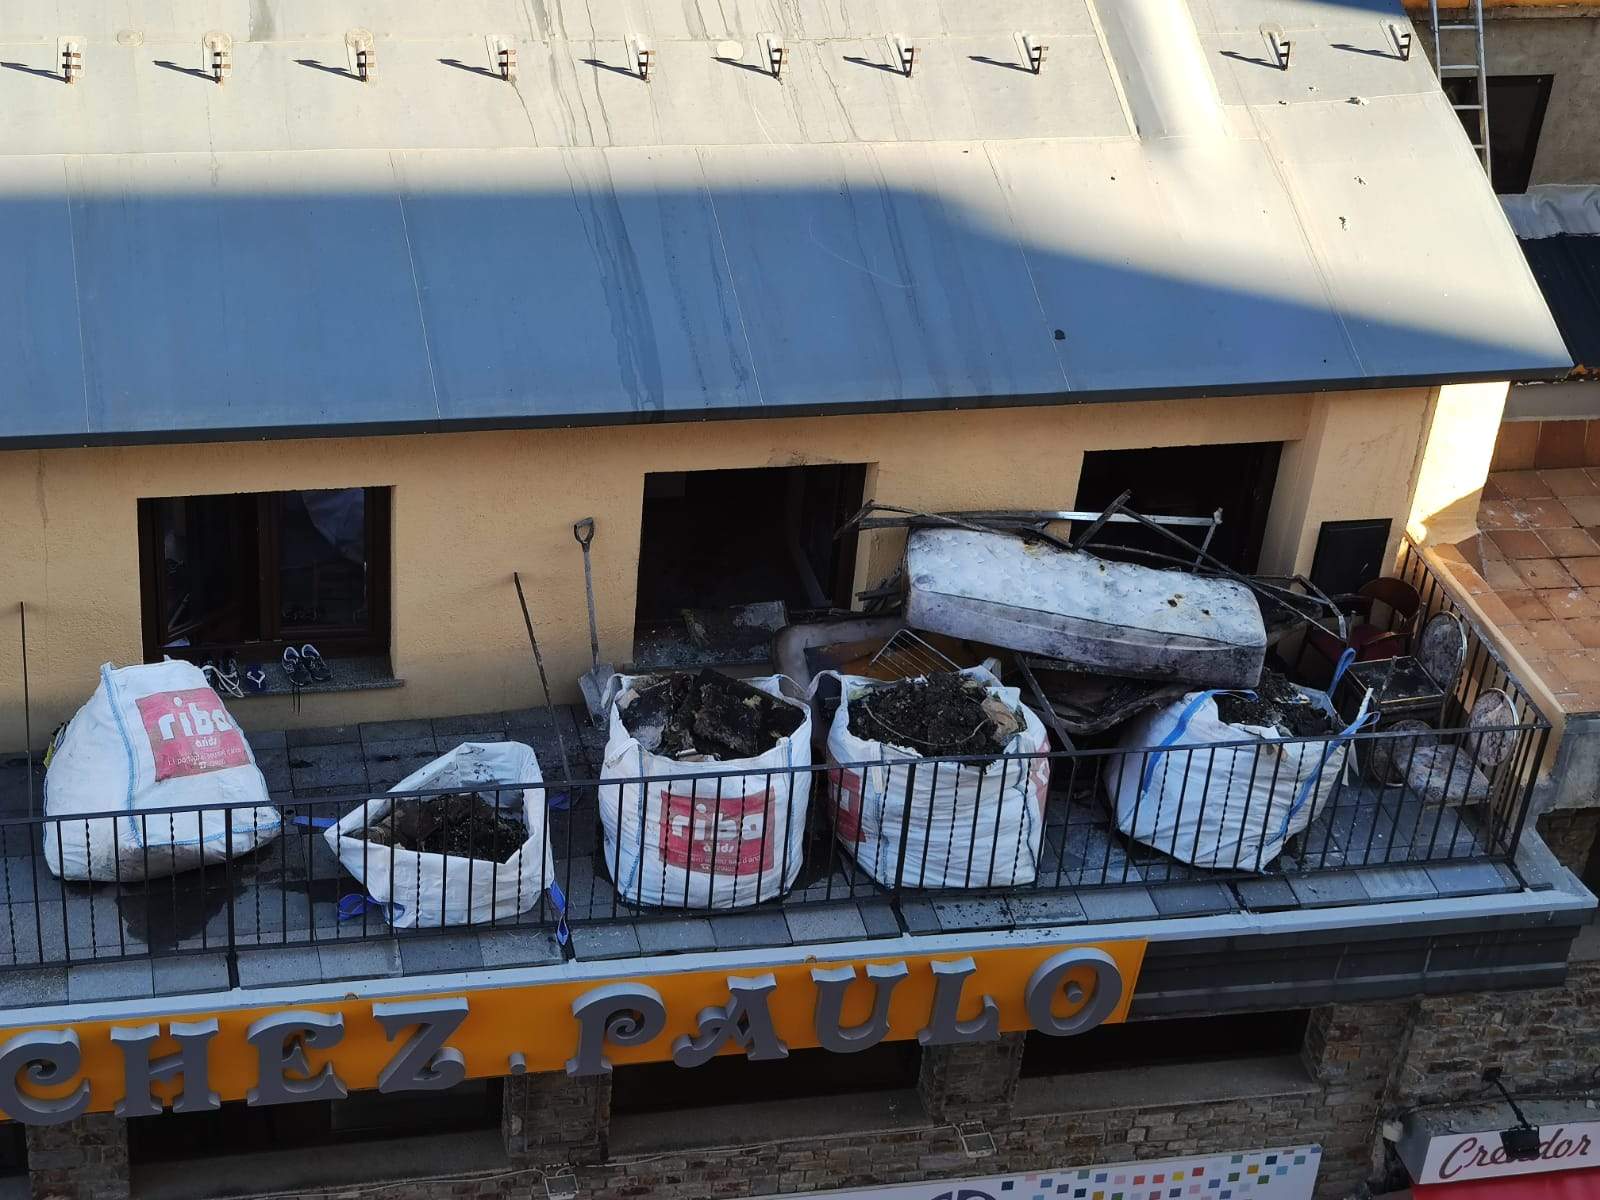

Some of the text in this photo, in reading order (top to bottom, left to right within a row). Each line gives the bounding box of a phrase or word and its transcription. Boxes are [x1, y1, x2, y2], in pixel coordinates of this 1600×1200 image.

[672, 804, 765, 840] riba
[0, 997, 469, 1125] CHEZ
[565, 947, 1124, 1076] PAULO
[1438, 1127, 1592, 1180] Credor
